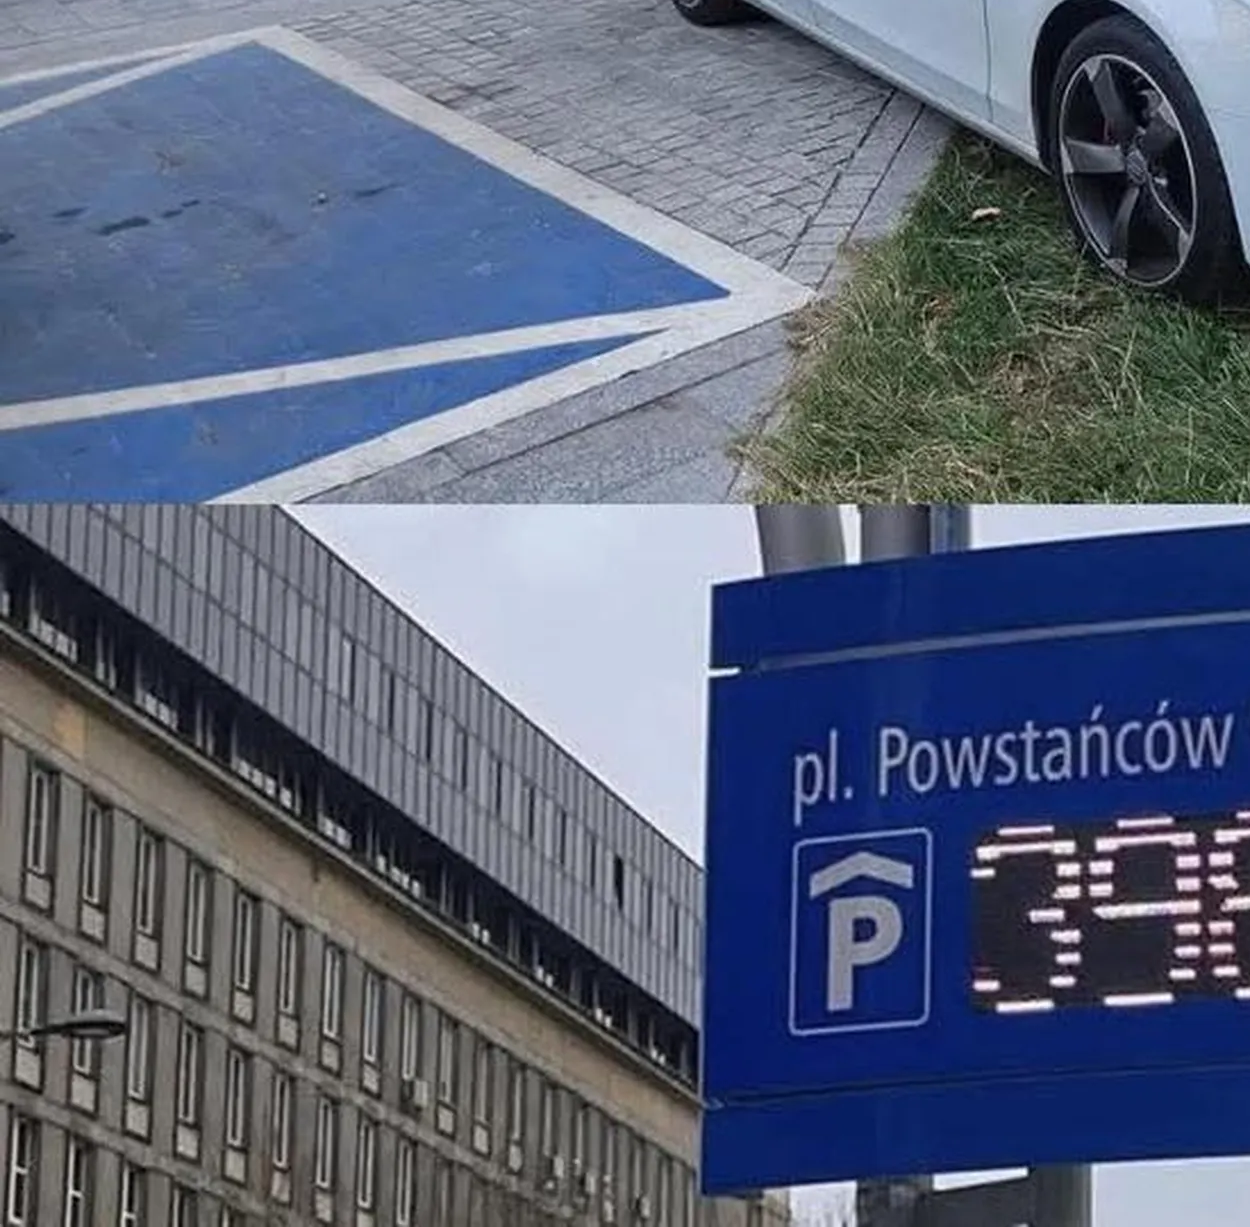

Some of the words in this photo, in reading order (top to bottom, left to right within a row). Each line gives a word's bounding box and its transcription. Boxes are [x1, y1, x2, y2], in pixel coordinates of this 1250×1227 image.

[792, 728, 855, 826] pl.
[877, 699, 1235, 799] Powstańców
[826, 896, 903, 1012] P
